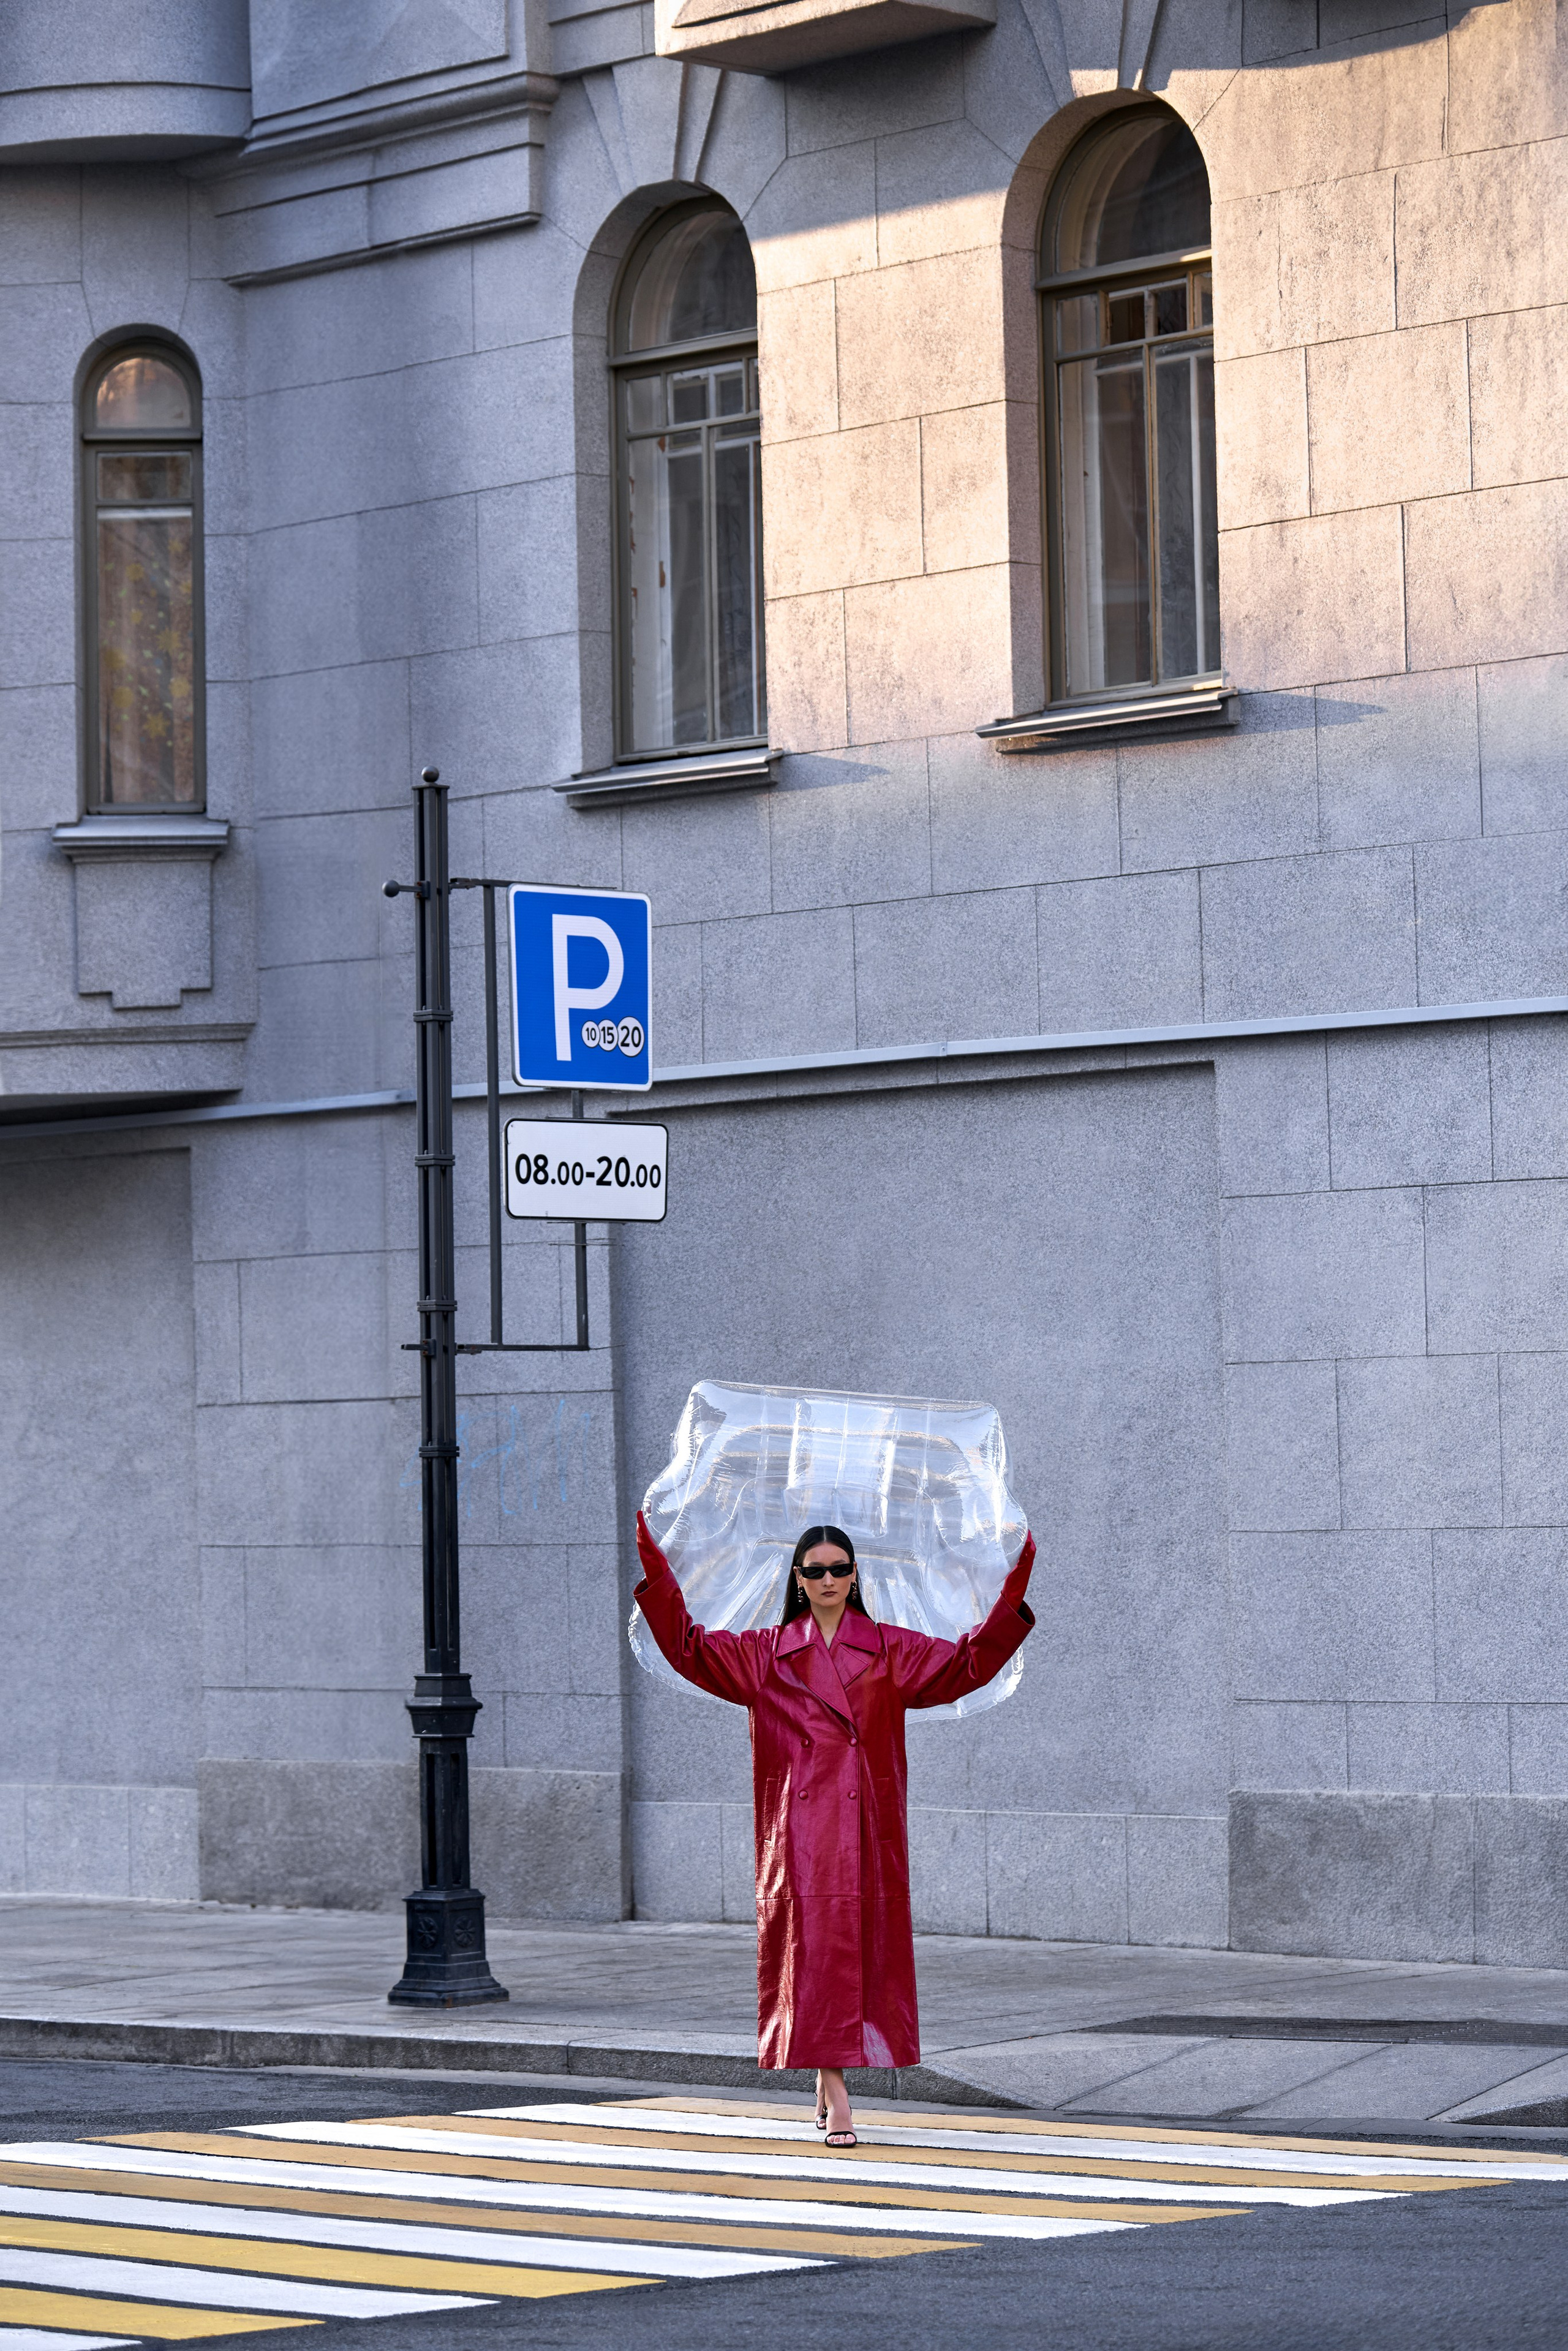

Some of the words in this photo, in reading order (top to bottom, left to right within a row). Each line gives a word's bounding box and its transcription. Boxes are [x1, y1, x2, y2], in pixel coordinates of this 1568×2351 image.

[552, 913, 624, 1062] P
[586, 1027, 597, 1041] 10
[601, 1026, 614, 1044] 15
[620, 1025, 641, 1047] 20
